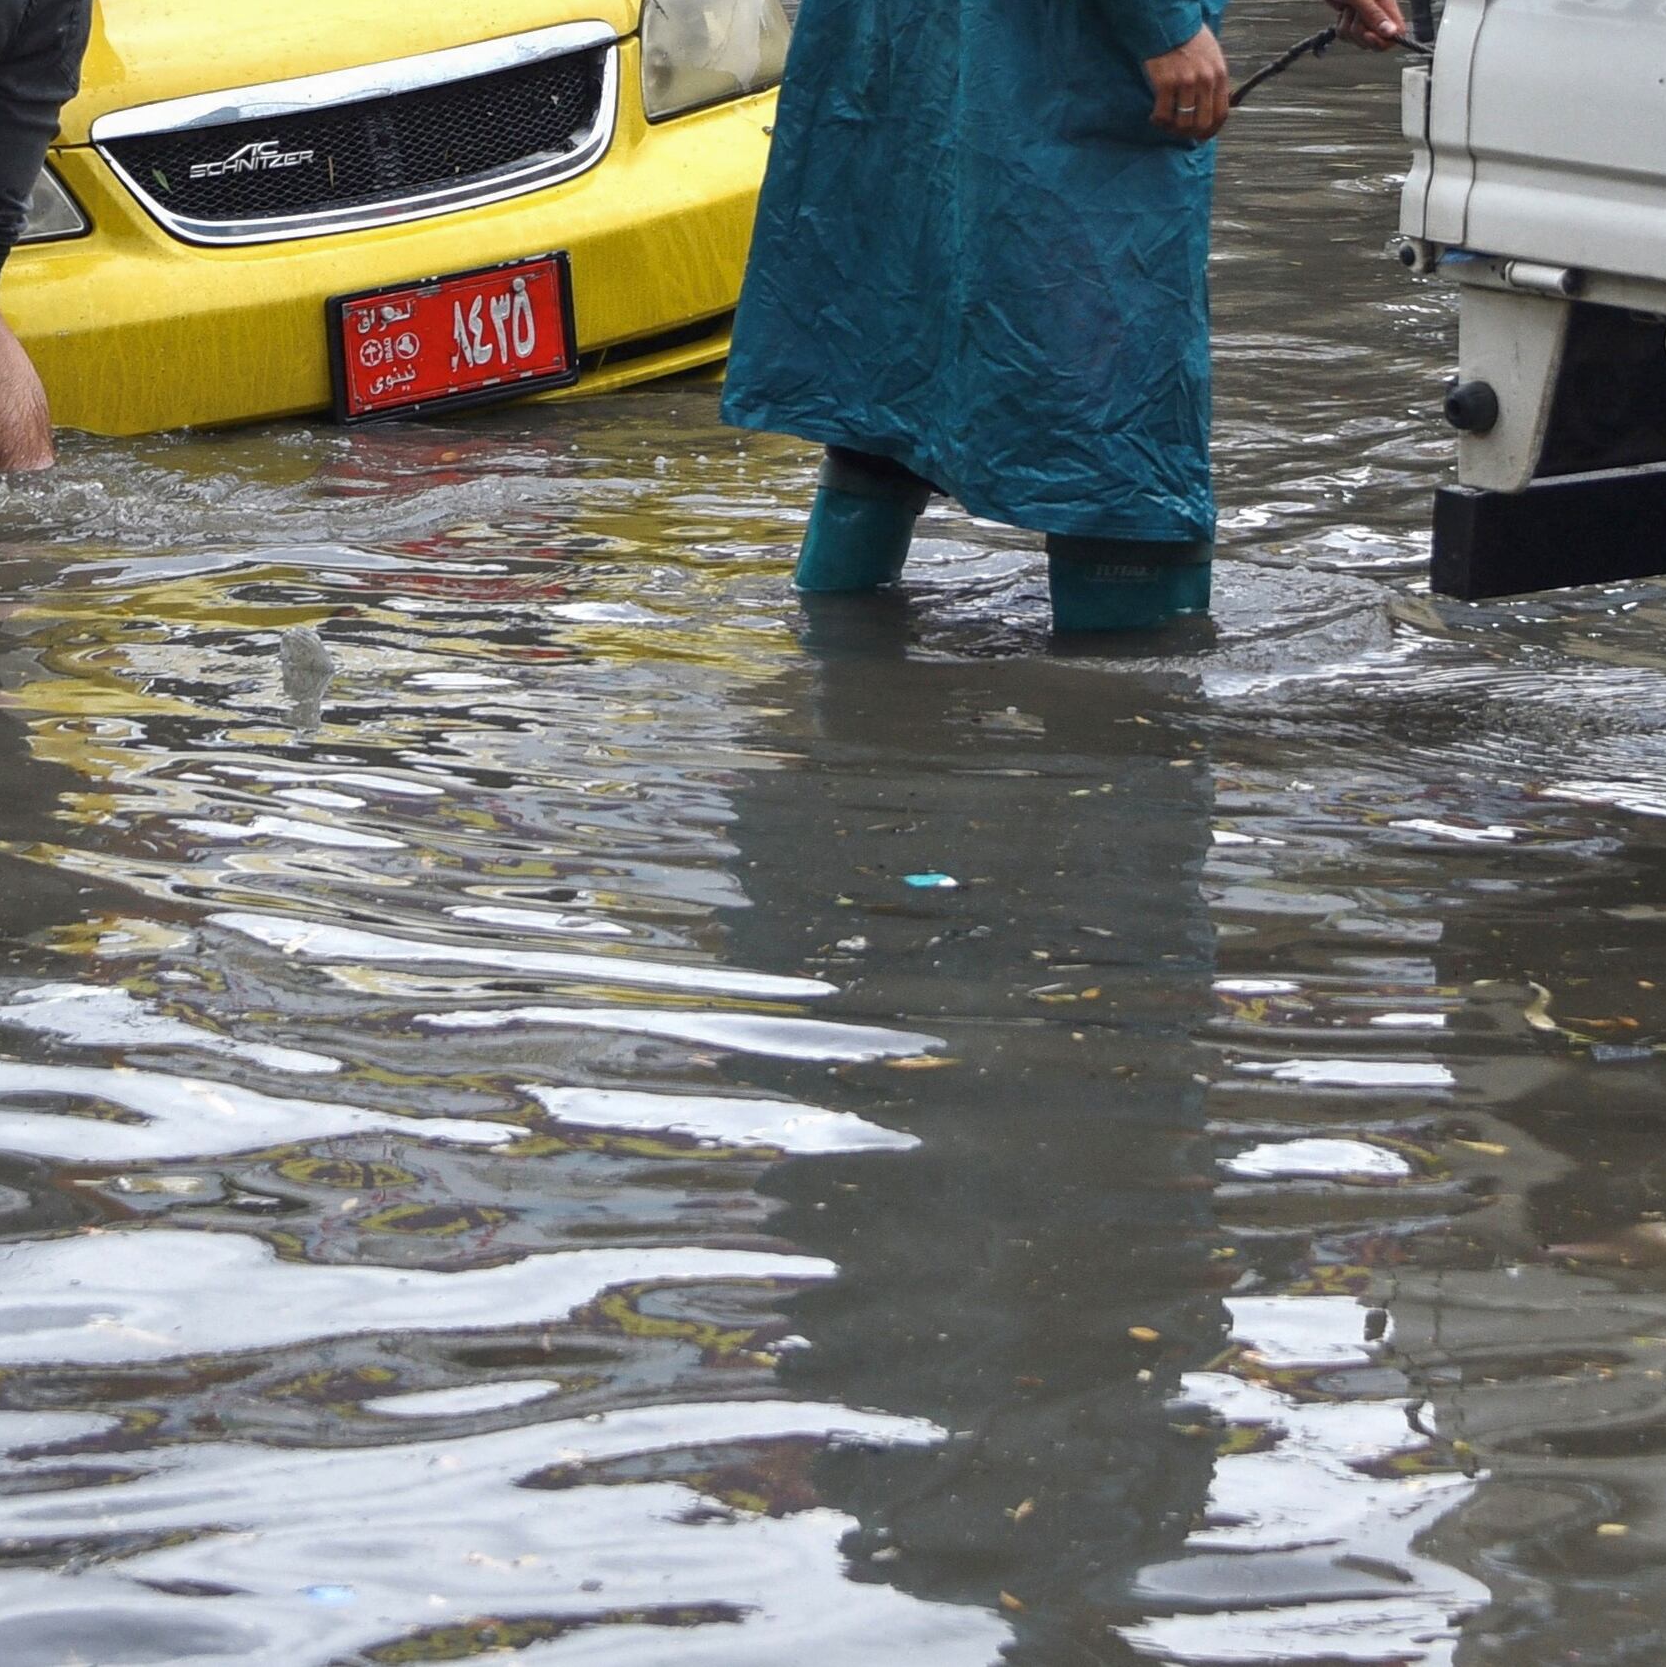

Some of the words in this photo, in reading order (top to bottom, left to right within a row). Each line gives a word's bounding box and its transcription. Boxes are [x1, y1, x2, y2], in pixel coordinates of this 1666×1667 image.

[189, 150, 314, 179] SCHNITZER
[225, 140, 280, 162] AC
[451, 286, 536, 372] ٨٤٣٥
[384, 337, 394, 363] IRAQ
[369, 364, 416, 395] نينوى
